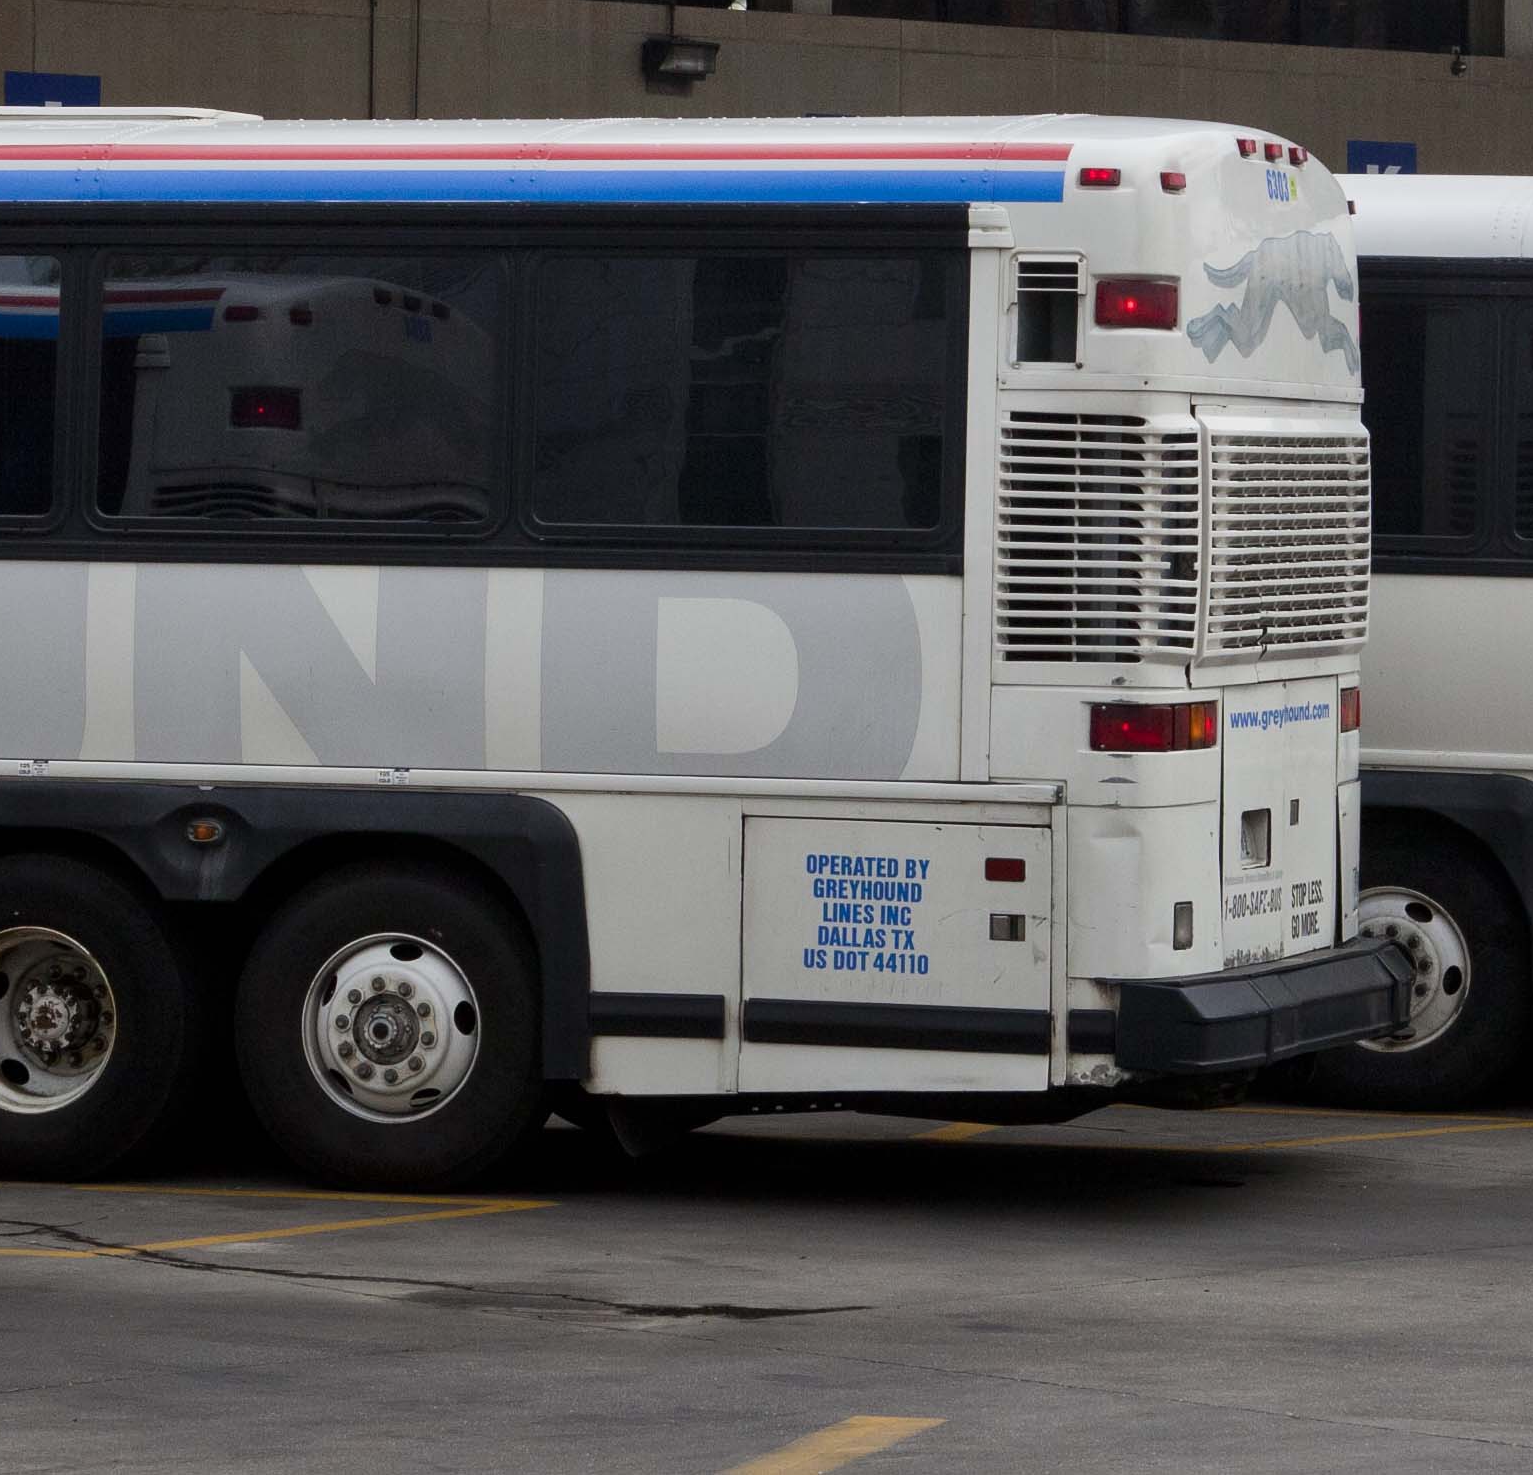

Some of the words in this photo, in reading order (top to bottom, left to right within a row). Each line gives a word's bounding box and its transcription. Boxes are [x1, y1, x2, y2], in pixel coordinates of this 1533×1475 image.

[1266, 168, 1290, 202] 6303
[1230, 700, 1330, 730] www.greyhound.com
[806, 854, 899, 878] OPERATED
[905, 858, 931, 880] BY
[813, 877, 922, 903] GREYHOUND
[1291, 882, 1307, 908] STOP
[822, 902, 875, 925] LINES
[880, 905, 912, 926] INC
[1291, 914, 1300, 939] GO
[817, 925, 887, 949] DALLAS
[891, 929, 915, 950] TX
[803, 948, 828, 969] US
[833, 949, 870, 971] DOT
[872, 952, 929, 975] 44110
